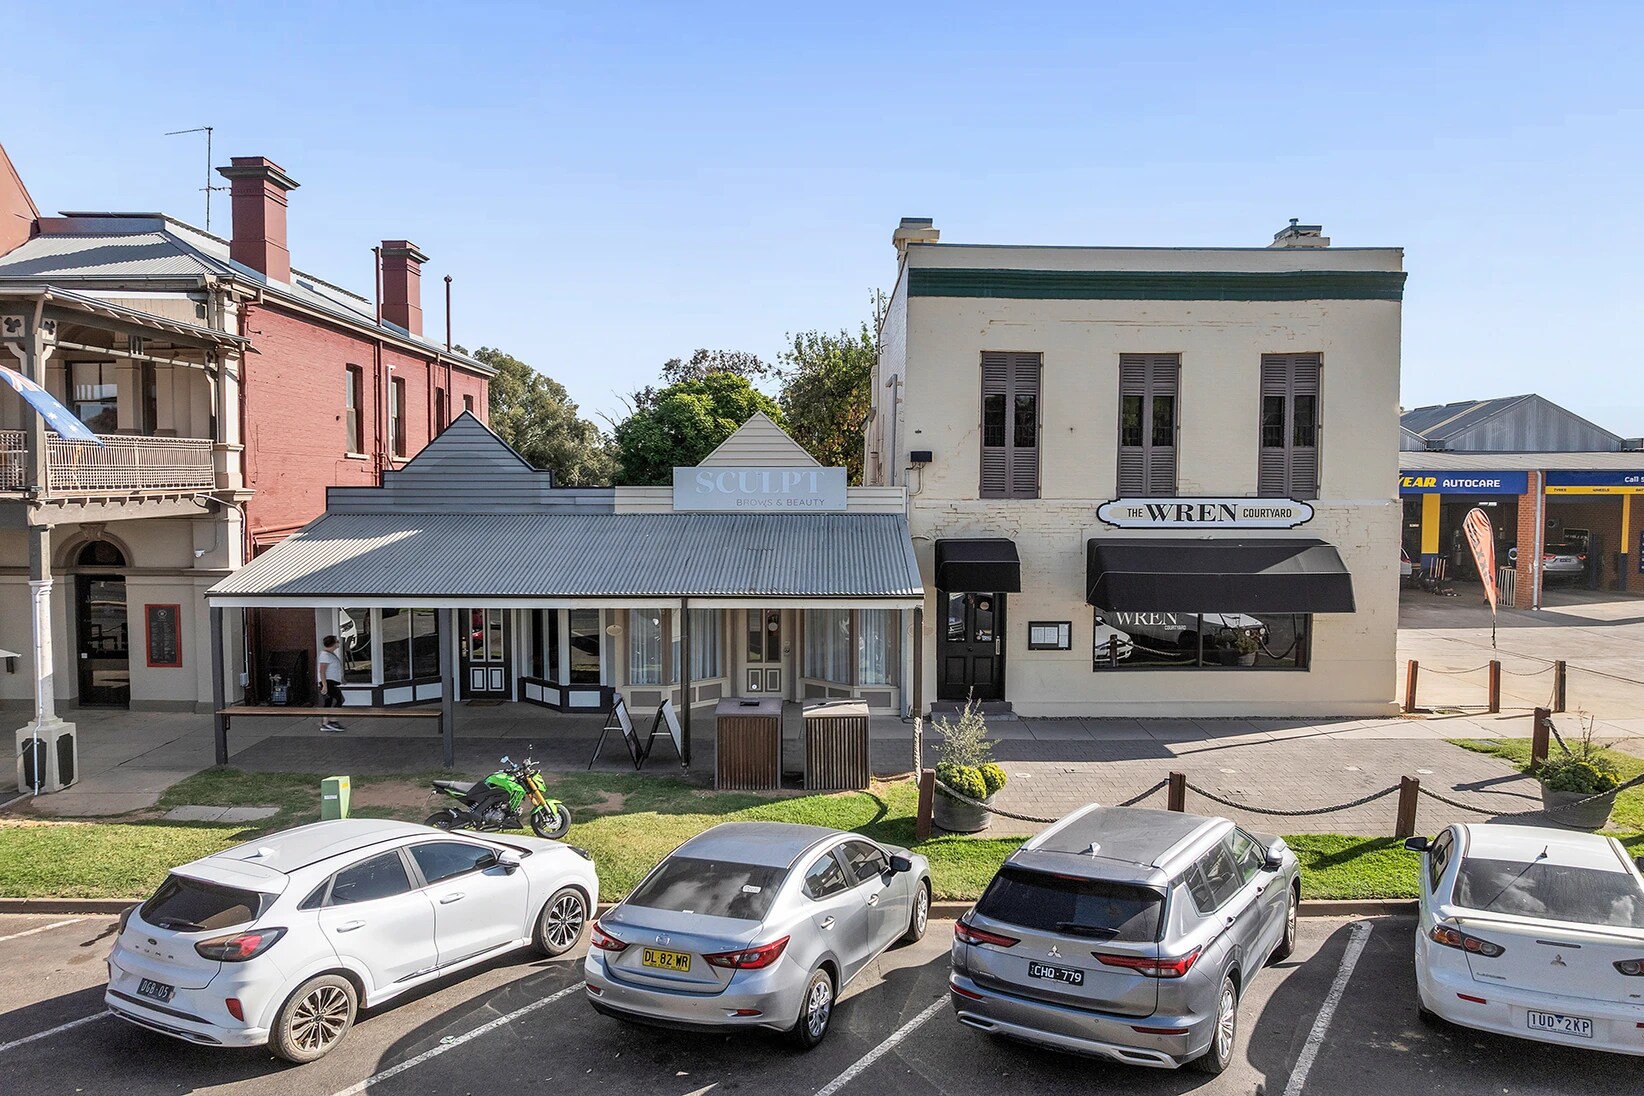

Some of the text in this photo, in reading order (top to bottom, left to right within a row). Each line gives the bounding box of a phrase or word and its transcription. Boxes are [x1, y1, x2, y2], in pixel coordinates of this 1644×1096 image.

[695, 471, 825, 494] SCULPT
[1442, 479, 1501, 488] AUTOCARE
[736, 499, 825, 507] BROWS & BEAUTY
[1127, 503, 1292, 522] THE WREN COURTYARD
[1116, 612, 1177, 626] WREN
[644, 950, 656, 963] DL
[660, 953, 673, 966] 82
[1565, 1018, 1590, 1033] 2KP
